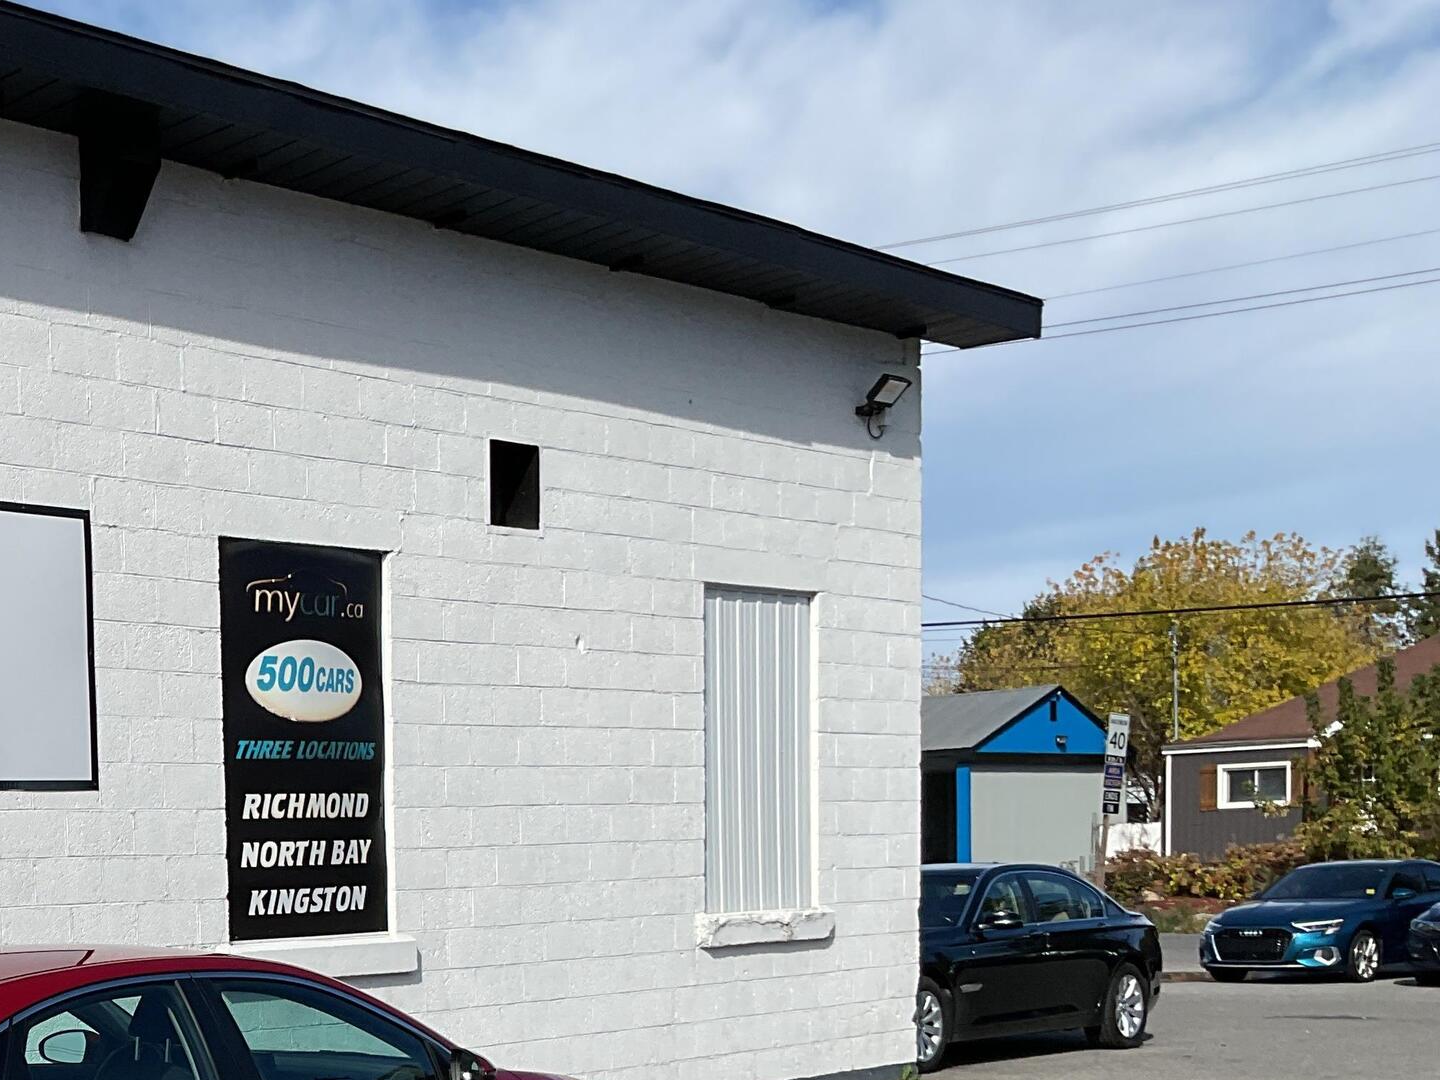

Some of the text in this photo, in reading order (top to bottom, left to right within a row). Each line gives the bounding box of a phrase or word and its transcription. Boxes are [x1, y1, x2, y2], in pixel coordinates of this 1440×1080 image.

[254, 588, 364, 622] mycar.ca
[235, 740, 376, 761] THREE LOCATIONS
[1110, 732, 1126, 750] 40
[242, 792, 369, 820] RICHMOND
[240, 839, 372, 868] NORTH BAY
[248, 885, 367, 916] KINGSTON
